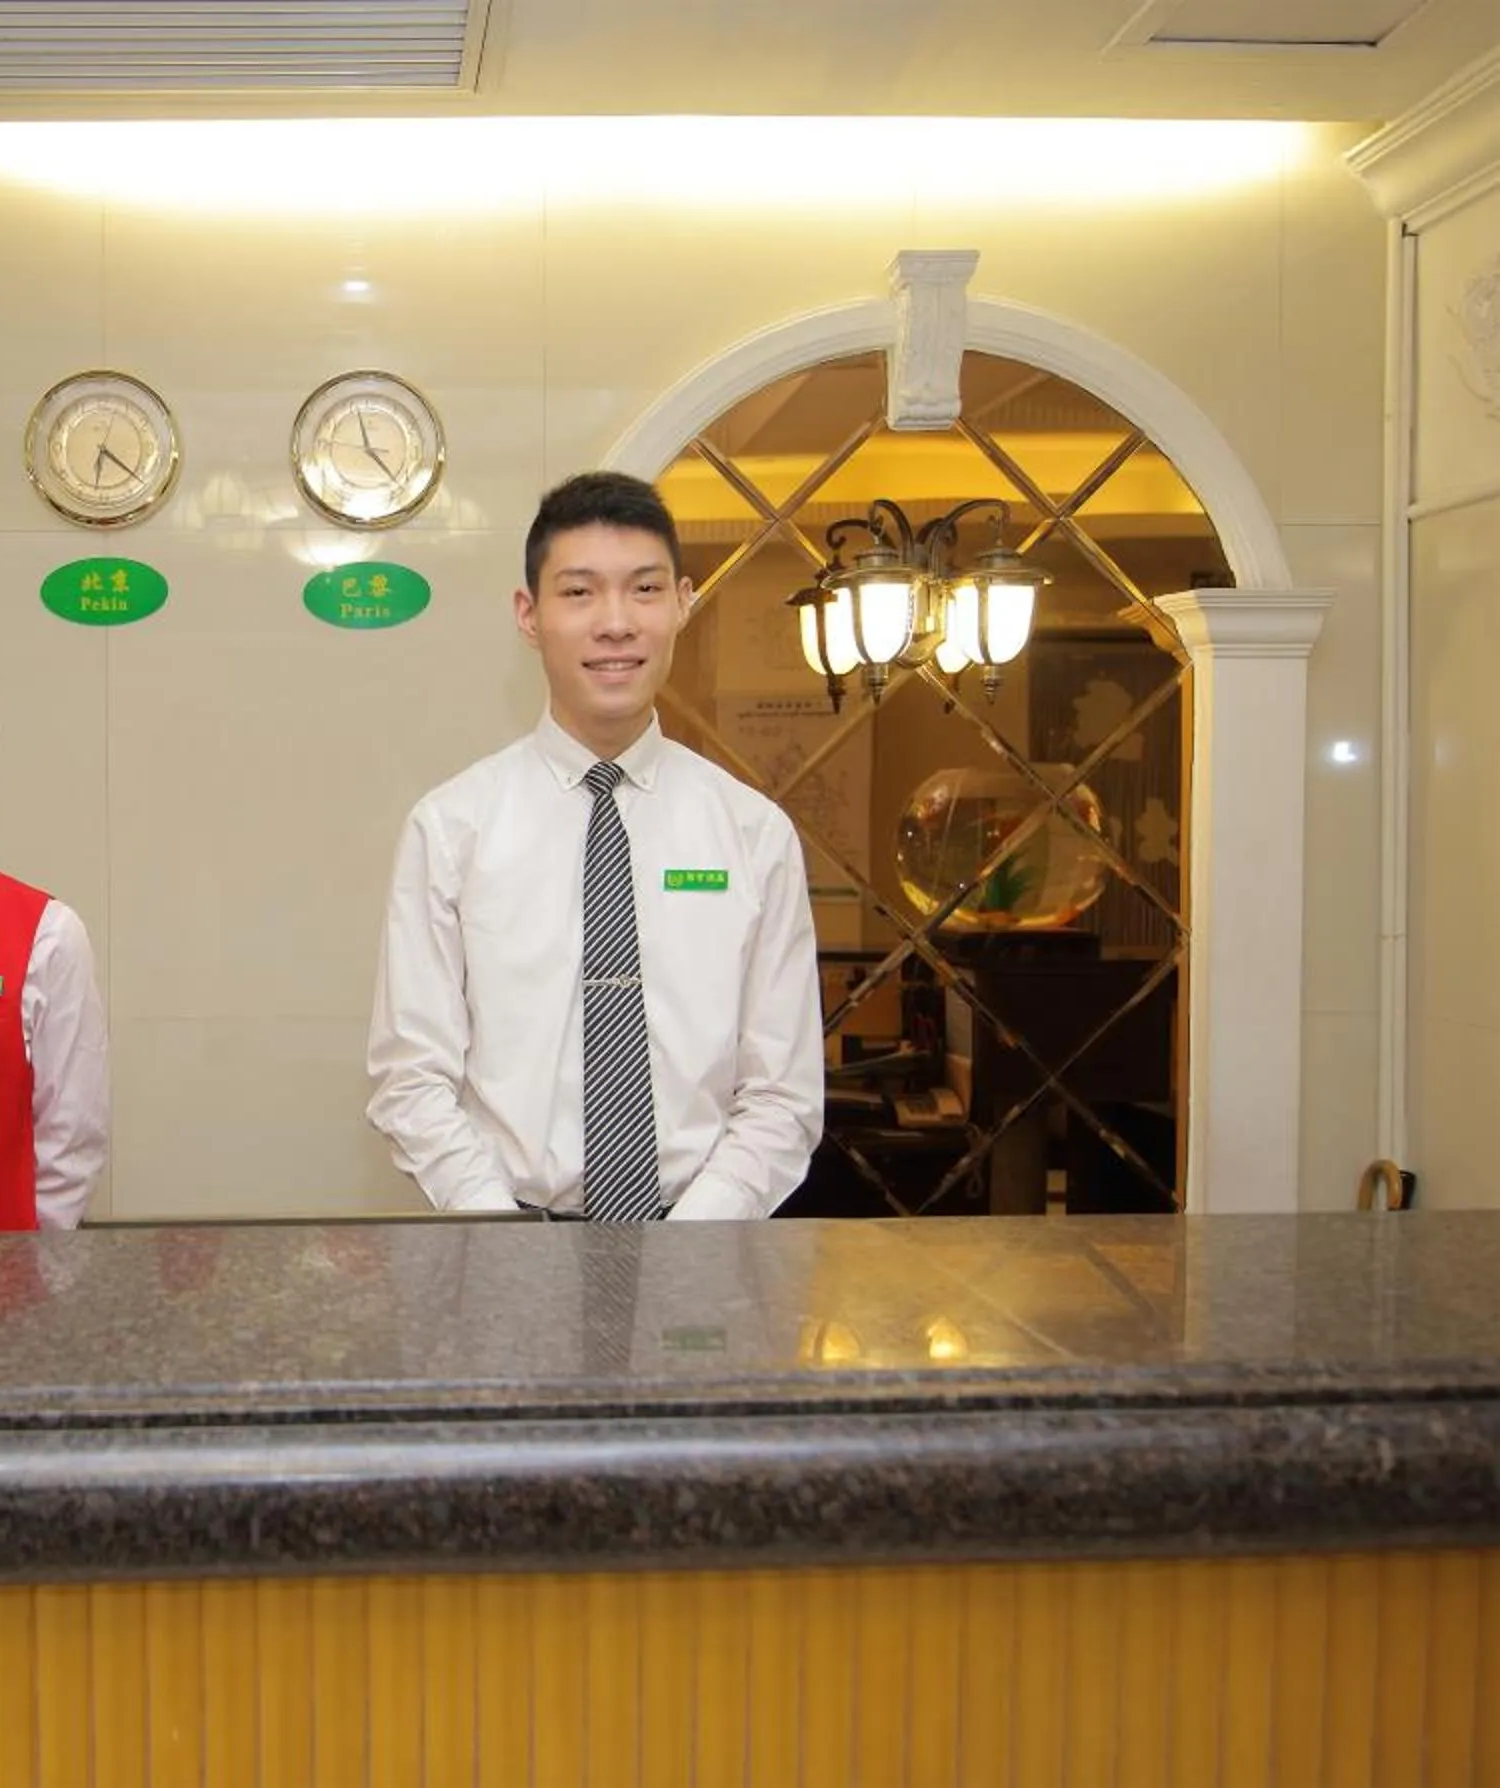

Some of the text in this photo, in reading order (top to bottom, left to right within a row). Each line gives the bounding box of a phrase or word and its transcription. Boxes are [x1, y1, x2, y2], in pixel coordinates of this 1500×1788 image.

[79, 569, 131, 593] 北京
[342, 574, 394, 598] 巴黎
[80, 596, 129, 612] Pekin
[340, 603, 390, 618] Paris
